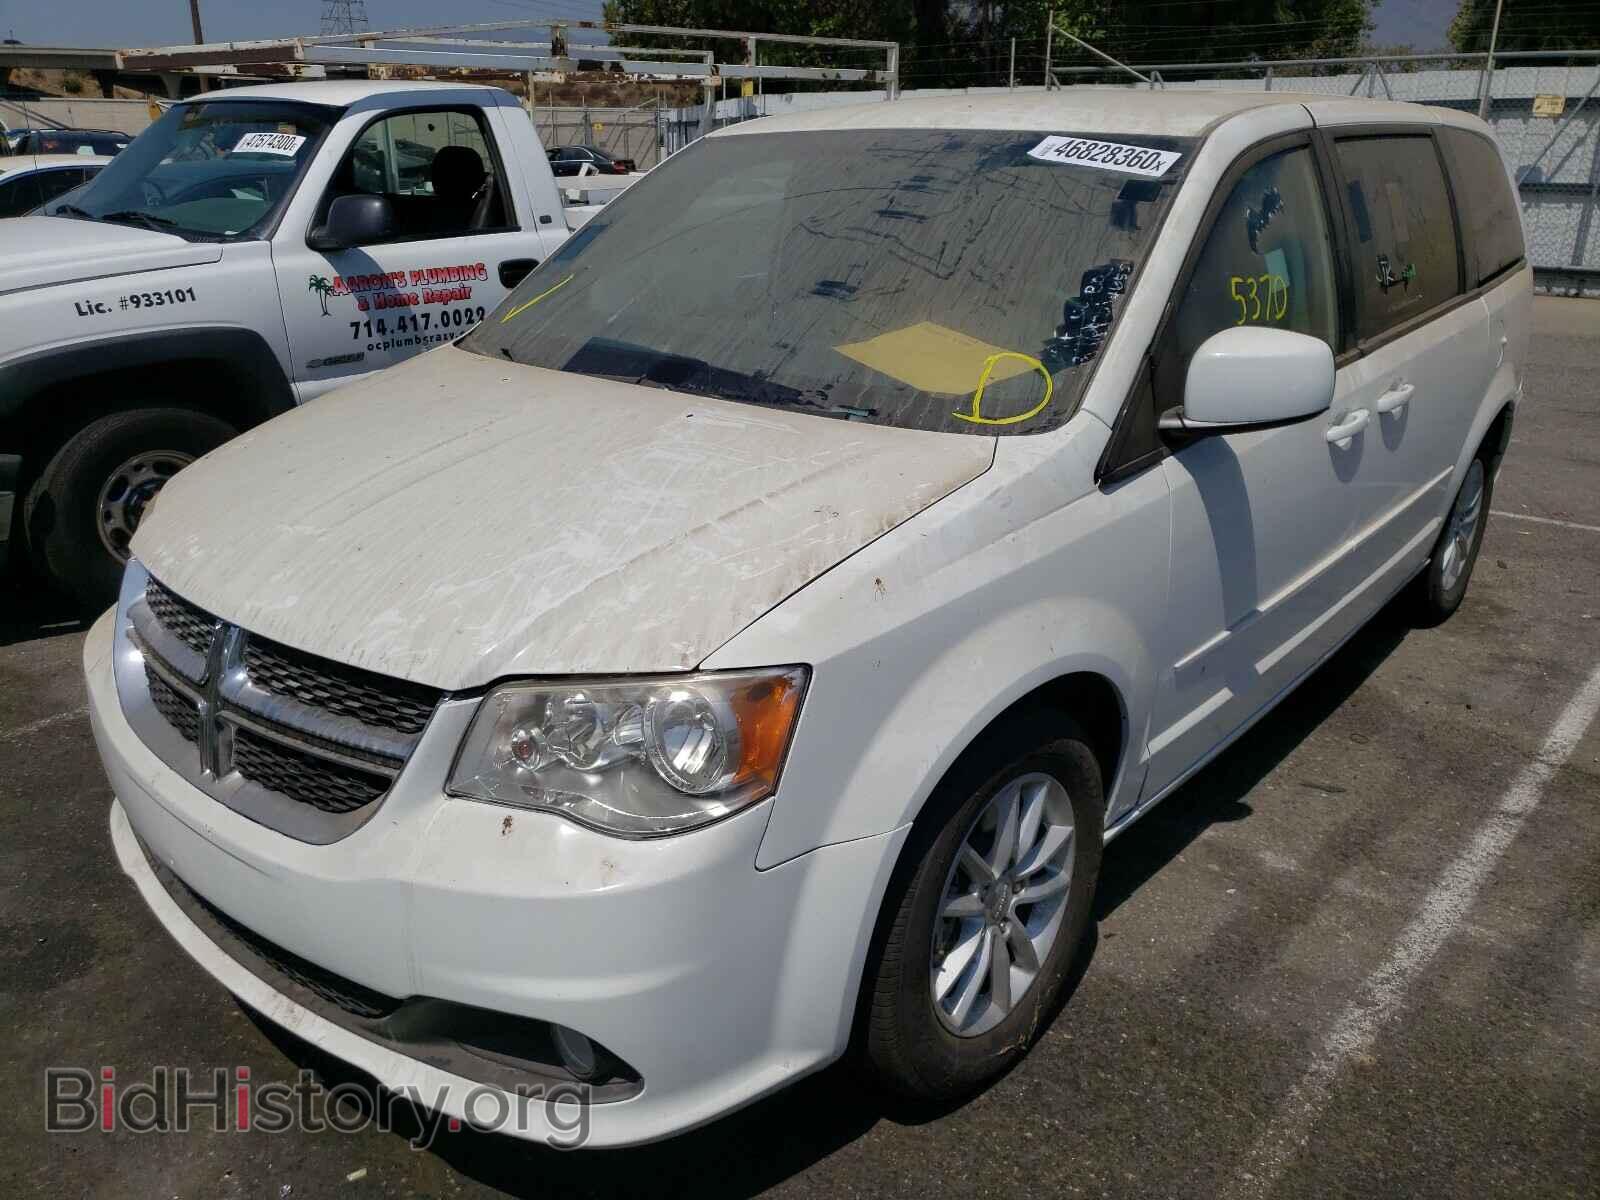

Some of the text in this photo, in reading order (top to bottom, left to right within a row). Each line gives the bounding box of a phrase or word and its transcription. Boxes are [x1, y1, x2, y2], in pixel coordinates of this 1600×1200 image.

[332, 262, 488, 296] AARON'S PLUMBING
[74, 286, 197, 317] Lic. #933101
[373, 291, 420, 310] Home
[422, 283, 472, 306] Repair
[1231, 274, 1288, 325] 5370
